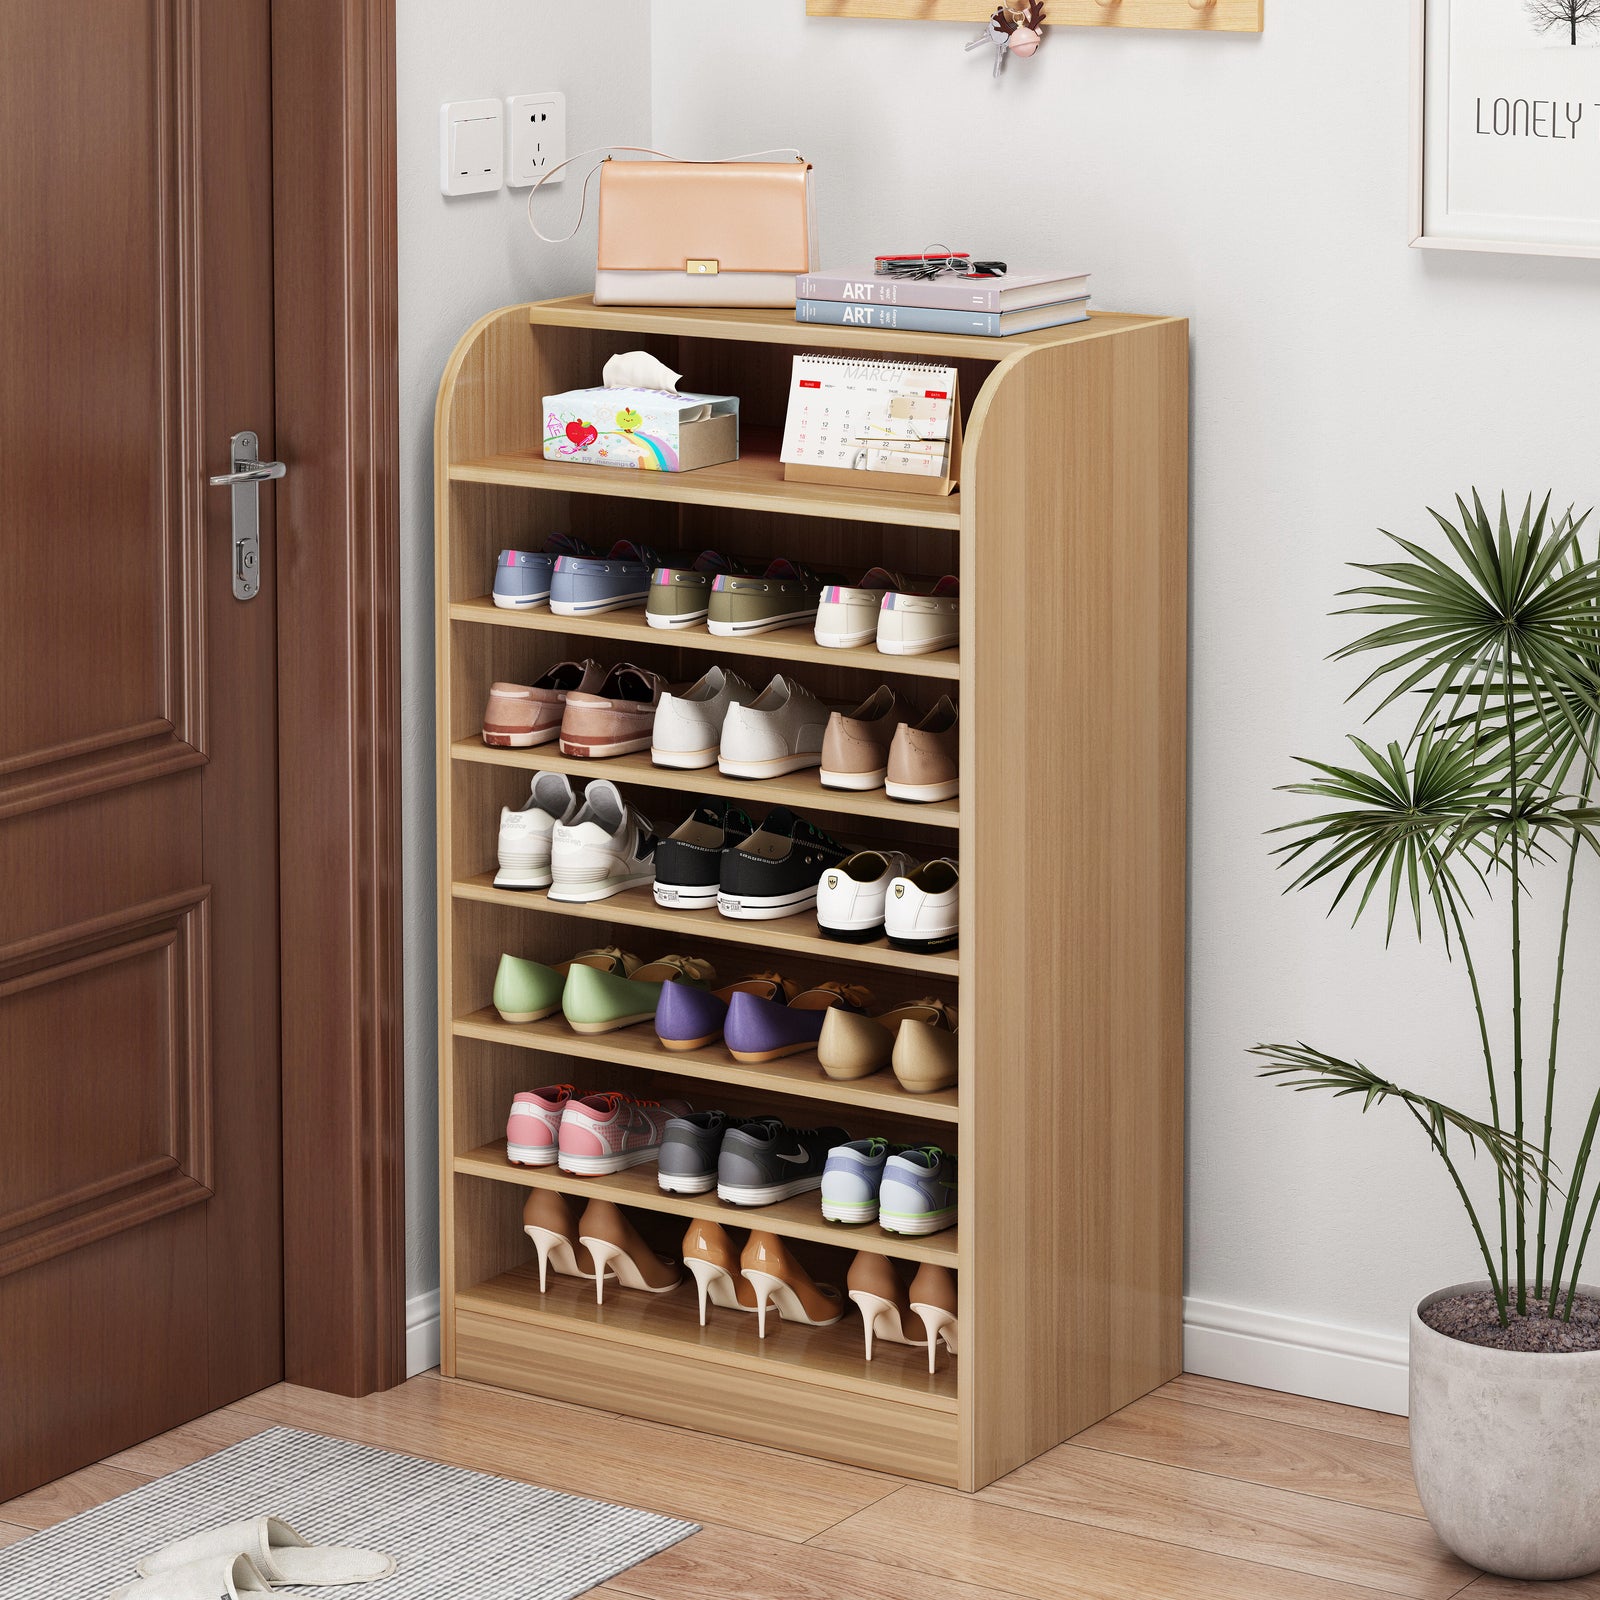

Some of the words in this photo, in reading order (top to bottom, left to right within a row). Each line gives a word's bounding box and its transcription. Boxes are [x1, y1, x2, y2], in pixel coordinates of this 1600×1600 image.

[1476, 97, 1582, 139] LONELY
[842, 282, 874, 300] ART
[842, 306, 874, 324] ART
[843, 367, 903, 382] MARCH
